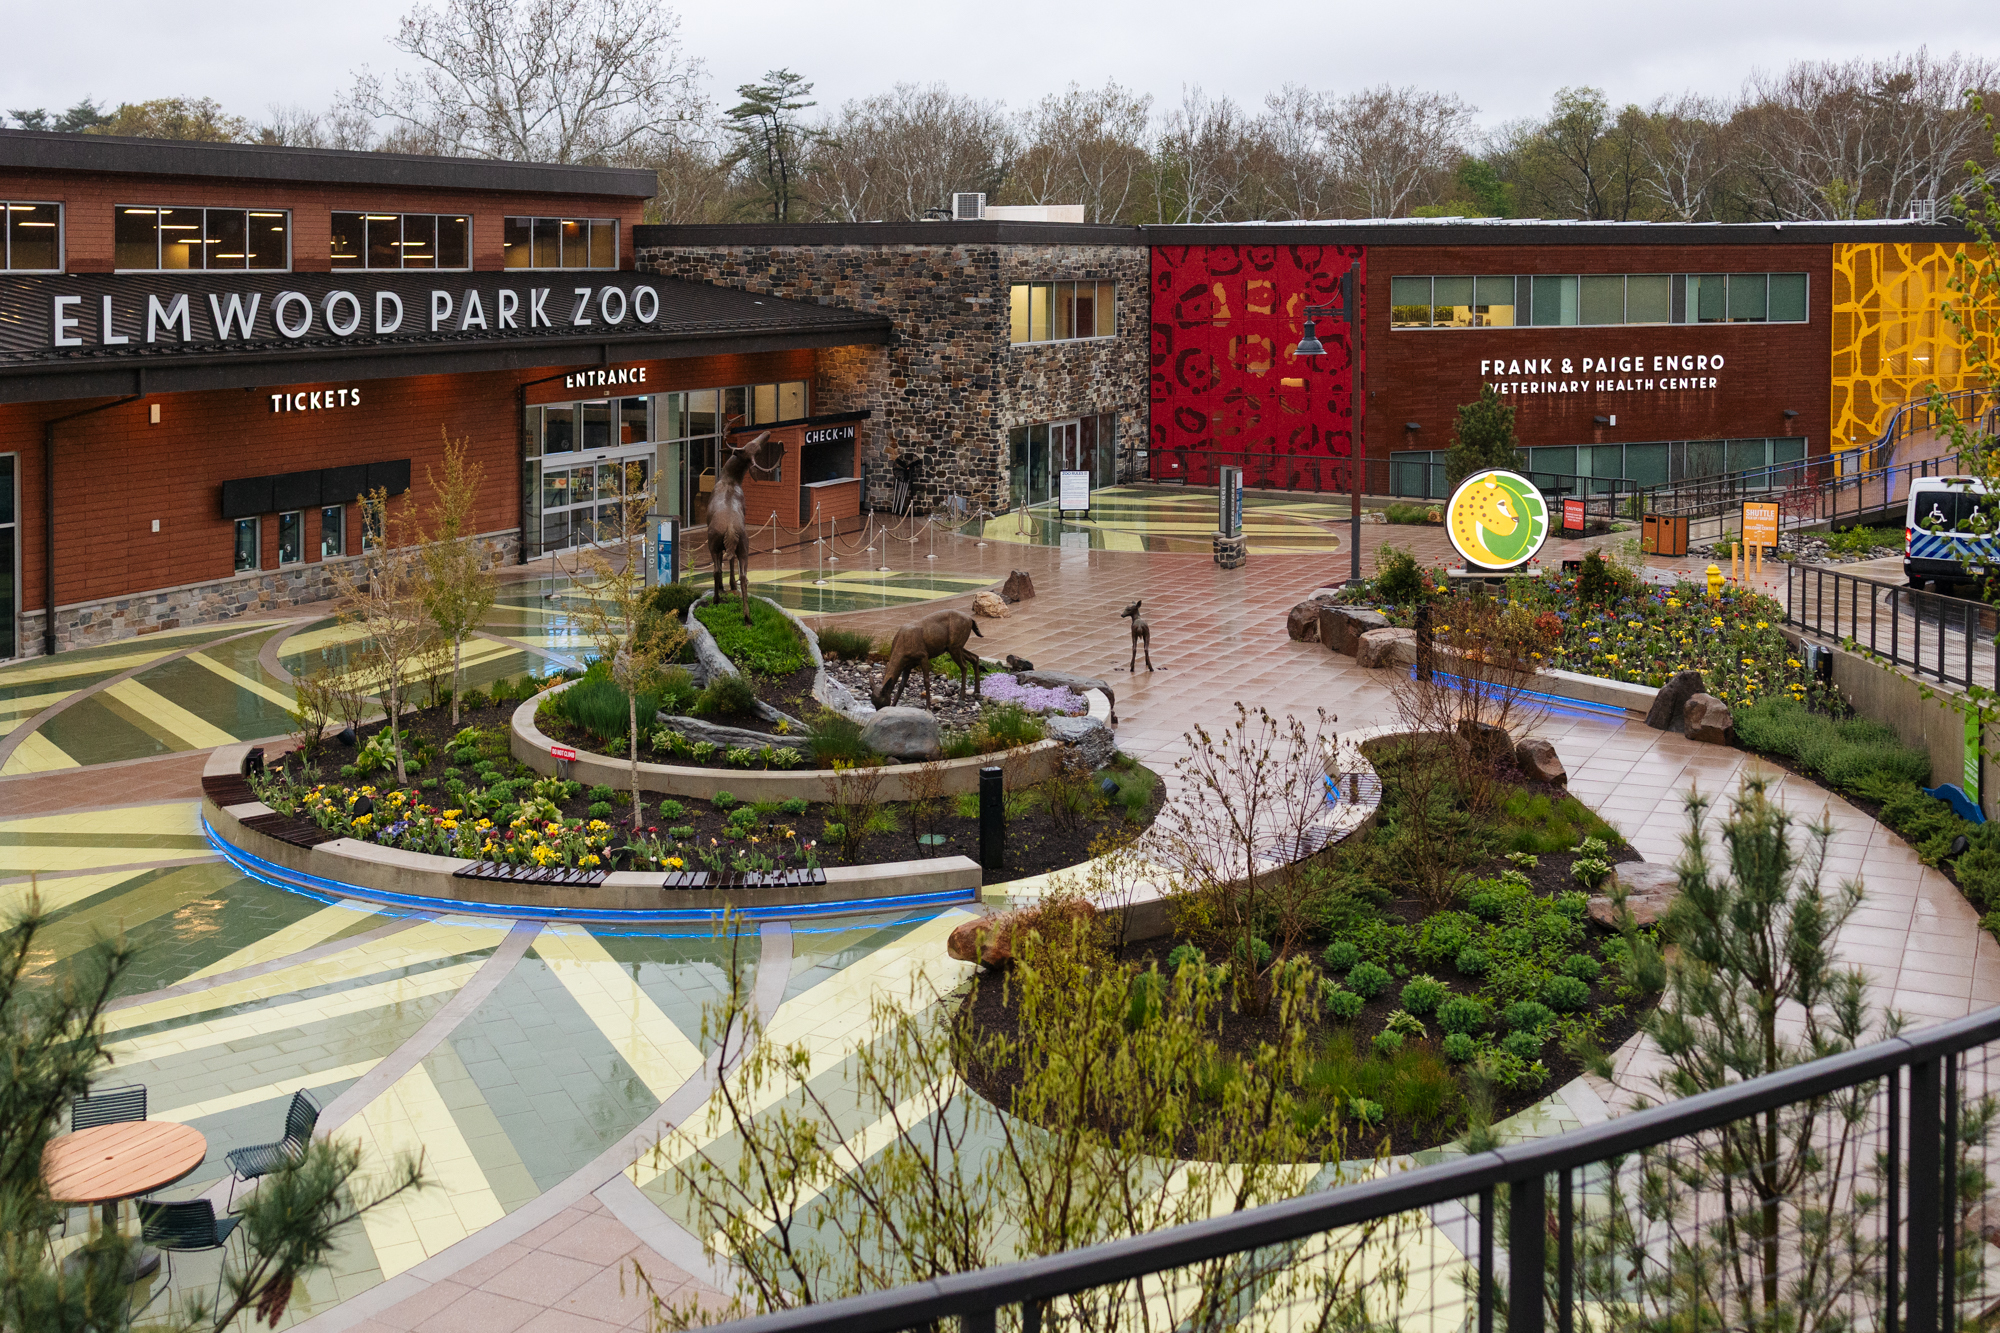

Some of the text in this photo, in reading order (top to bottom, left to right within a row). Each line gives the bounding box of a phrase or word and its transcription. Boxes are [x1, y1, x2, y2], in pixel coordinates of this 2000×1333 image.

[53, 285, 660, 347] ELMWOOD PARK ZOO
[1480, 354, 1725, 376] FRANK & PAIGE ENGRO
[566, 367, 646, 389] ENTRANCE
[1596, 378, 1654, 392] HEALTH
[1659, 376, 1717, 389] CENTER
[271, 387, 361, 413] TICKETS
[805, 426, 854, 444] CHECK-IN
